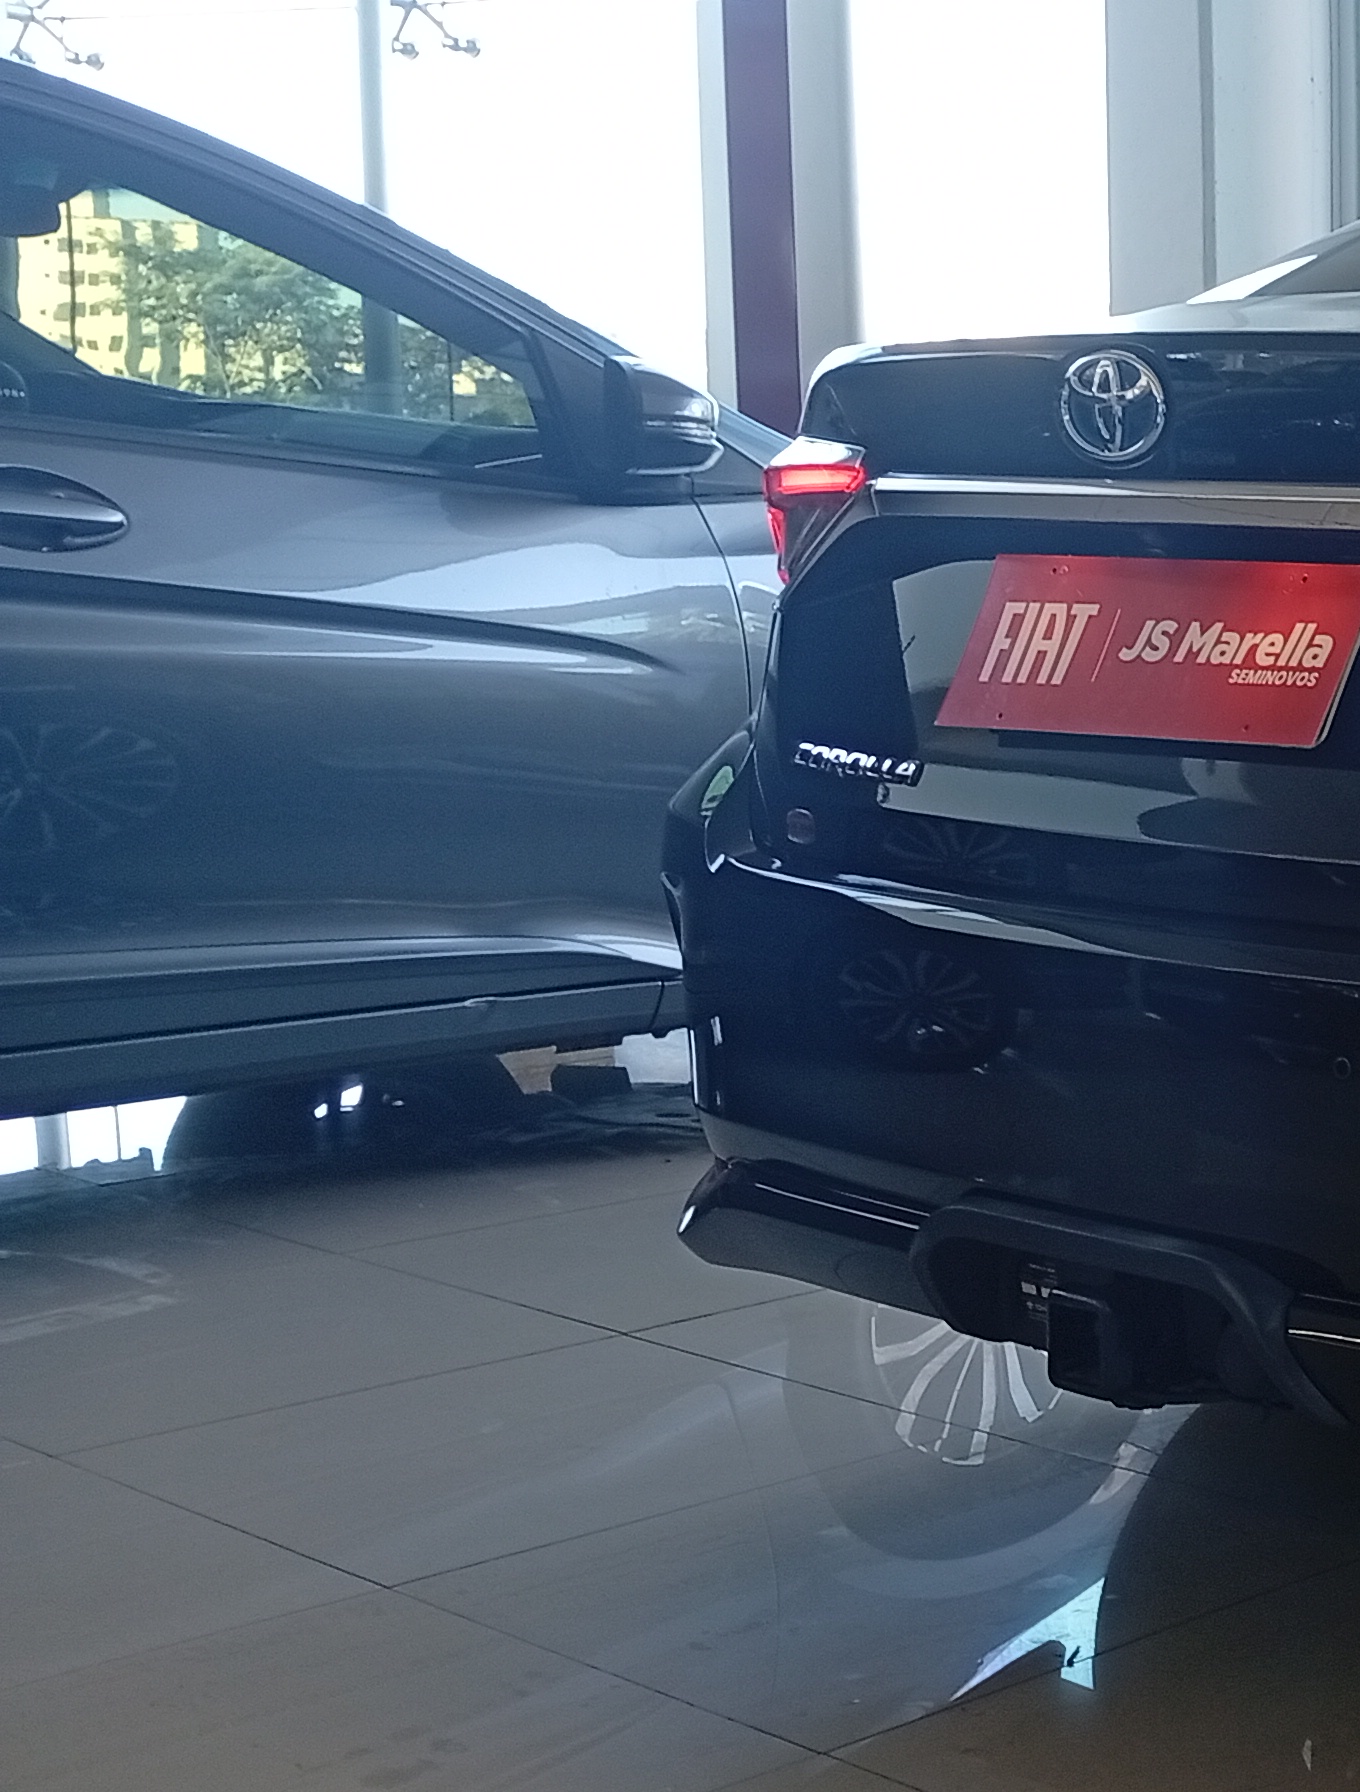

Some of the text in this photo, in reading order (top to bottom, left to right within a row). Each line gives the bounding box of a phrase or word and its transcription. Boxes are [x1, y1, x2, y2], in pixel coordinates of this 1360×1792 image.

[978, 601, 1101, 685] FIAT
[1118, 619, 1336, 669] JS Marella
[1228, 667, 1320, 688] SEMINOVOS
